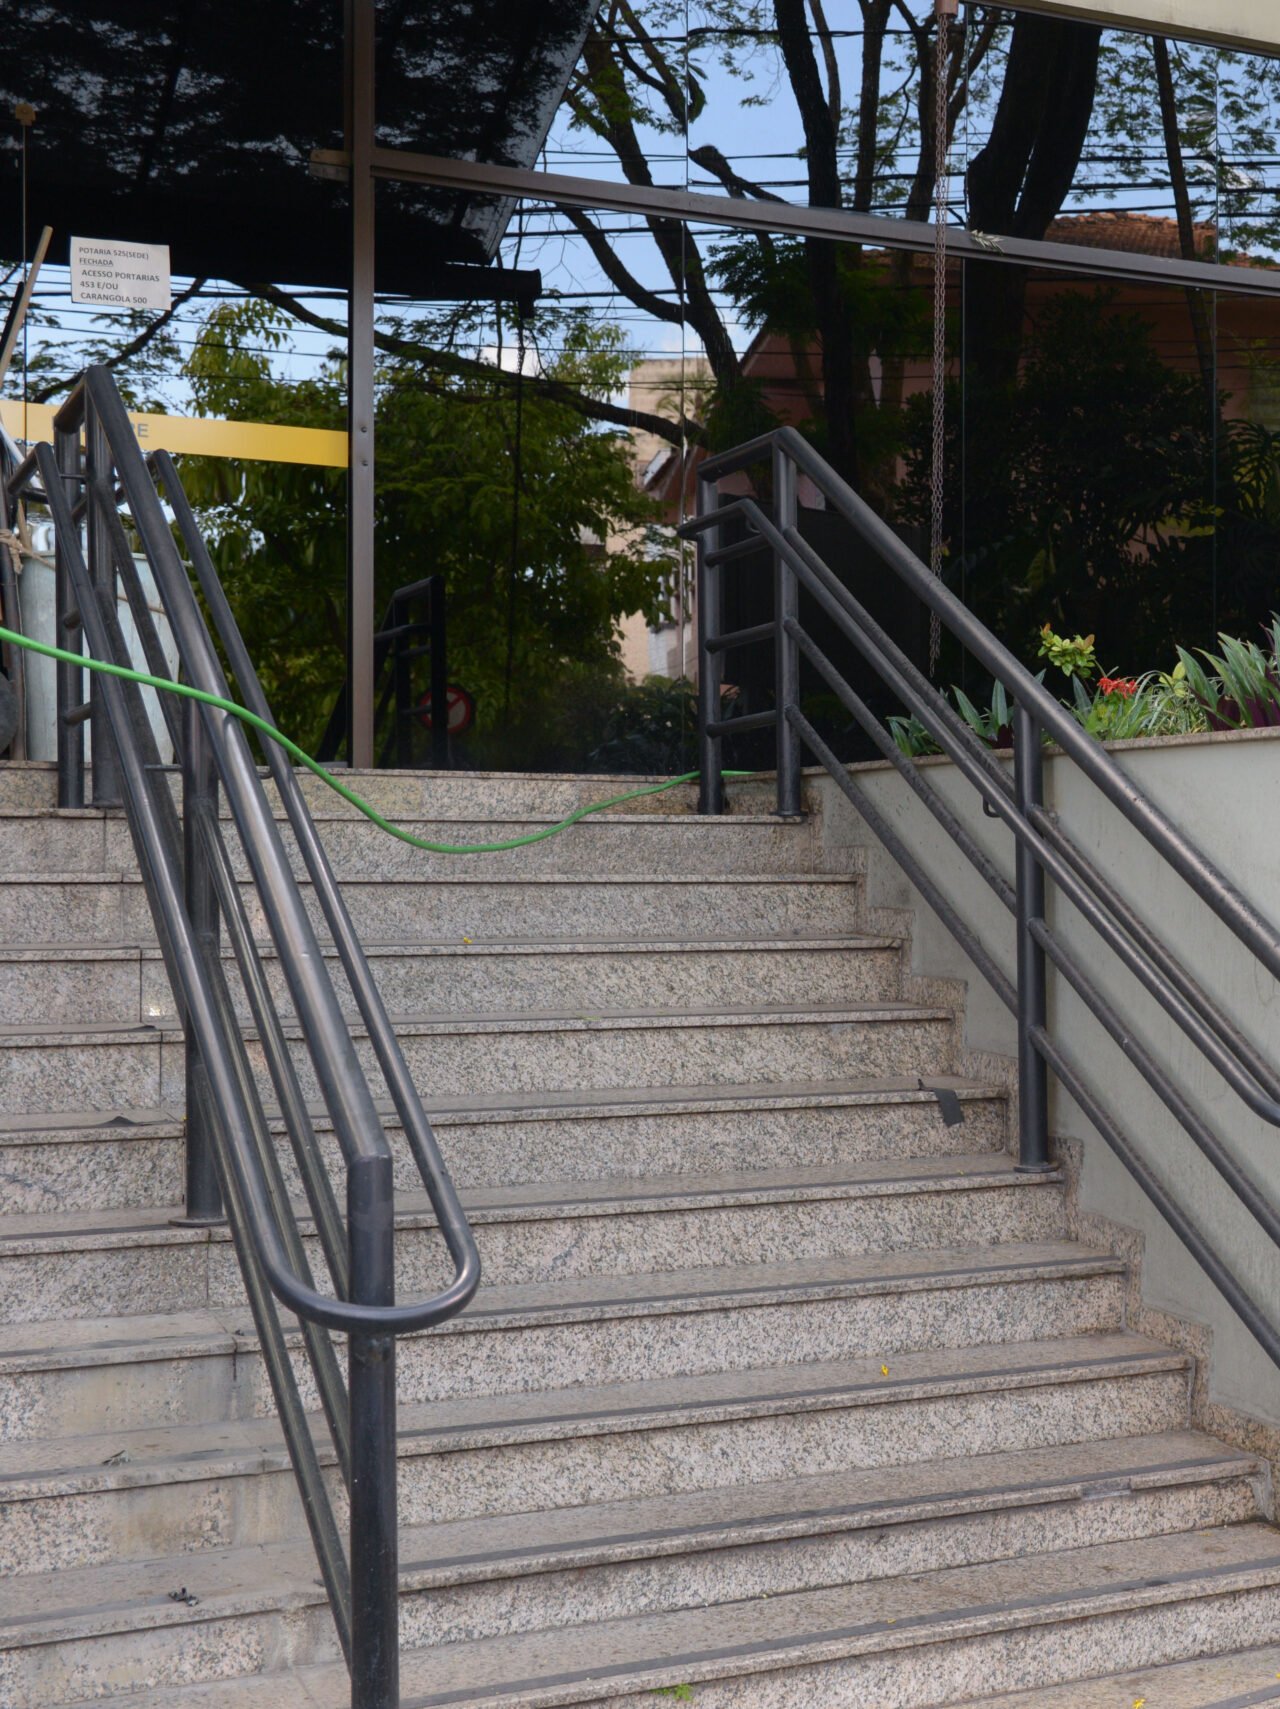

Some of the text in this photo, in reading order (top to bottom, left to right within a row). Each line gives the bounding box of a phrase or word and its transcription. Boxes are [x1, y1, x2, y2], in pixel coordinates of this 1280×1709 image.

[79, 258, 113, 267] FECHADA
[82, 269, 160, 282] ACESSO PORTARIAS
[97, 282, 119, 290] E/OU
[80, 292, 130, 303] CARANGOLA
